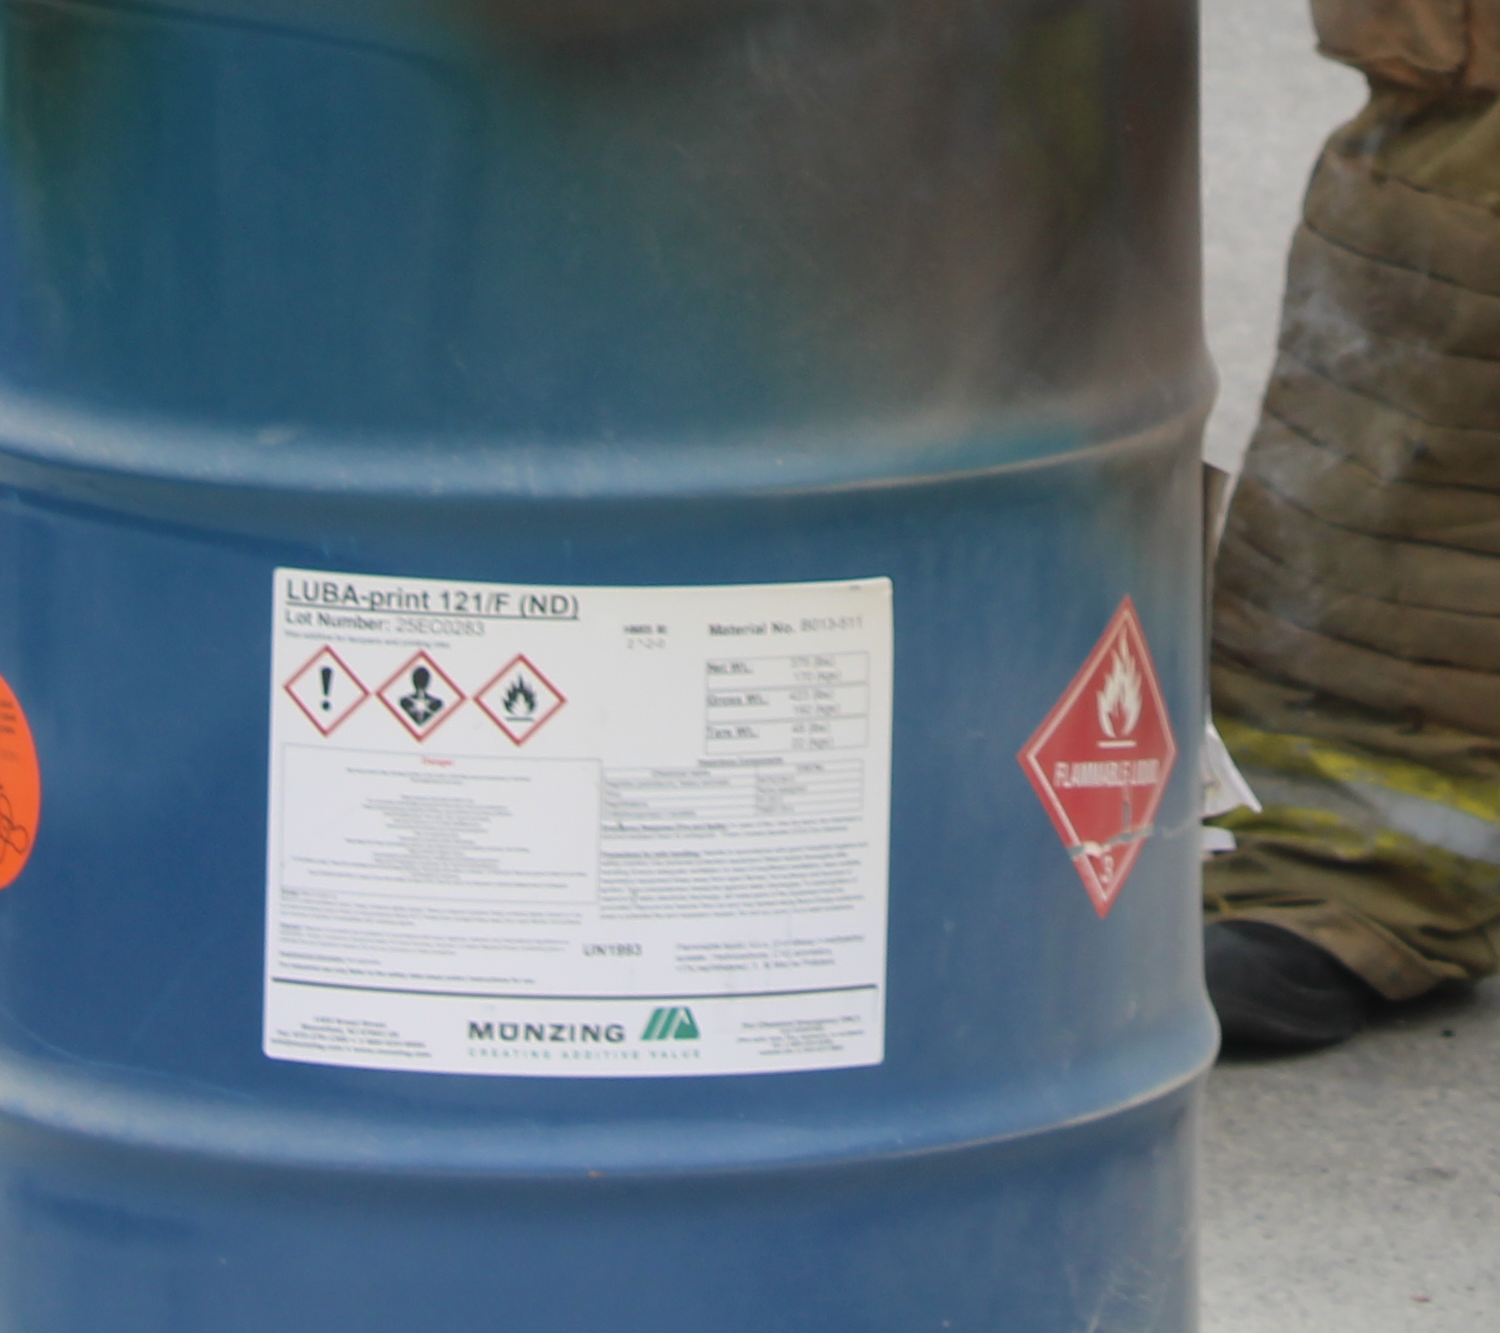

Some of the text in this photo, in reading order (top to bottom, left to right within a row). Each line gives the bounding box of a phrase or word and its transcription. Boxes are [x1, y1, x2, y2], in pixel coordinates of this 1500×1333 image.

[285, 579, 579, 619] LUBA-print 121/F (ND)
[285, 609, 312, 626] Lot
[317, 611, 391, 632] Number:
